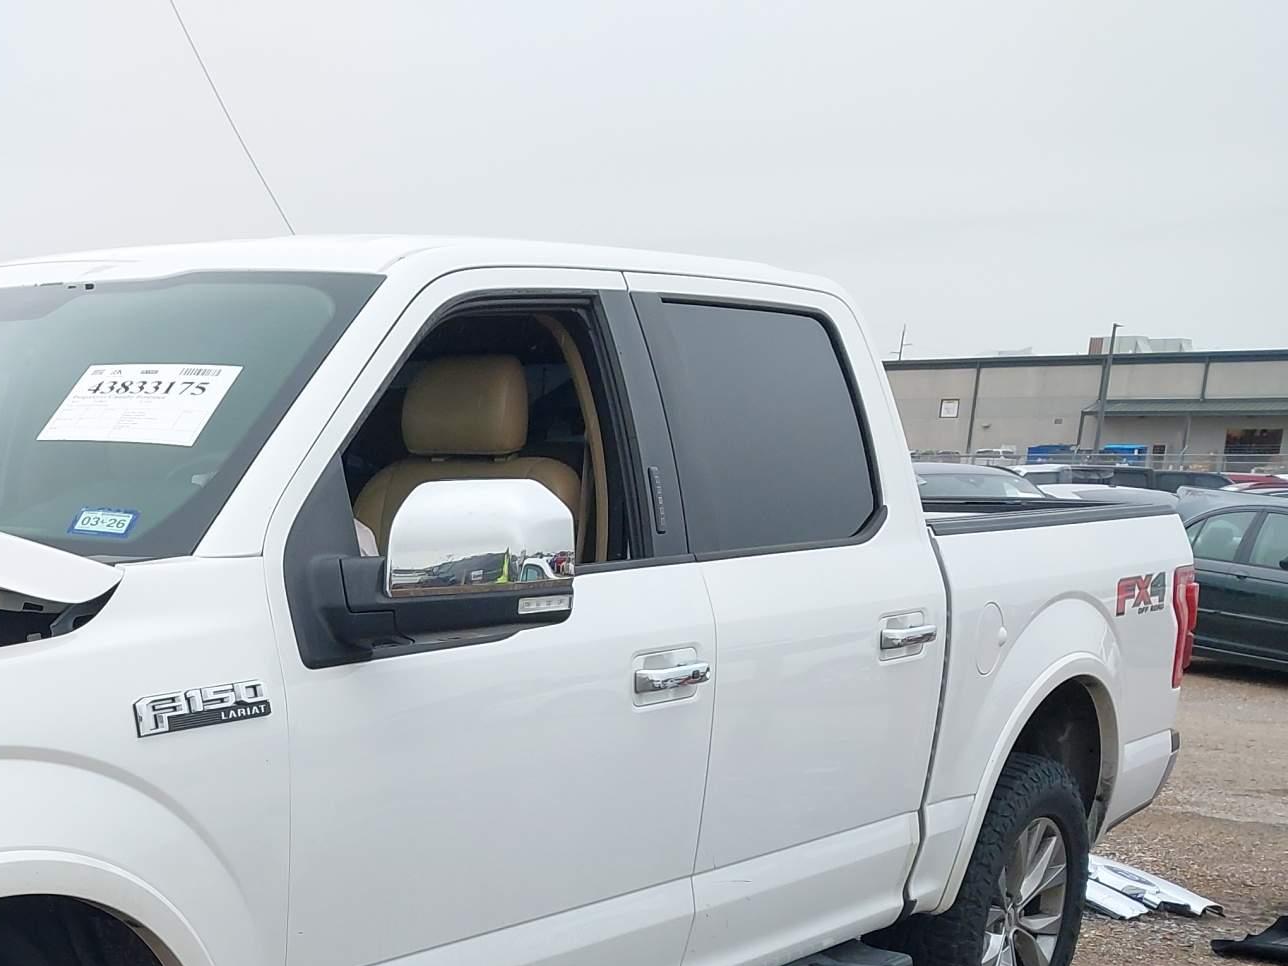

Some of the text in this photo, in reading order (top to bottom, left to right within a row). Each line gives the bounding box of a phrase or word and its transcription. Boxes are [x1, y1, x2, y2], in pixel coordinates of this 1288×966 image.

[88, 380, 210, 396] 43833175
[1115, 572, 1165, 616] FX4
[220, 704, 267, 720] LARIAT
